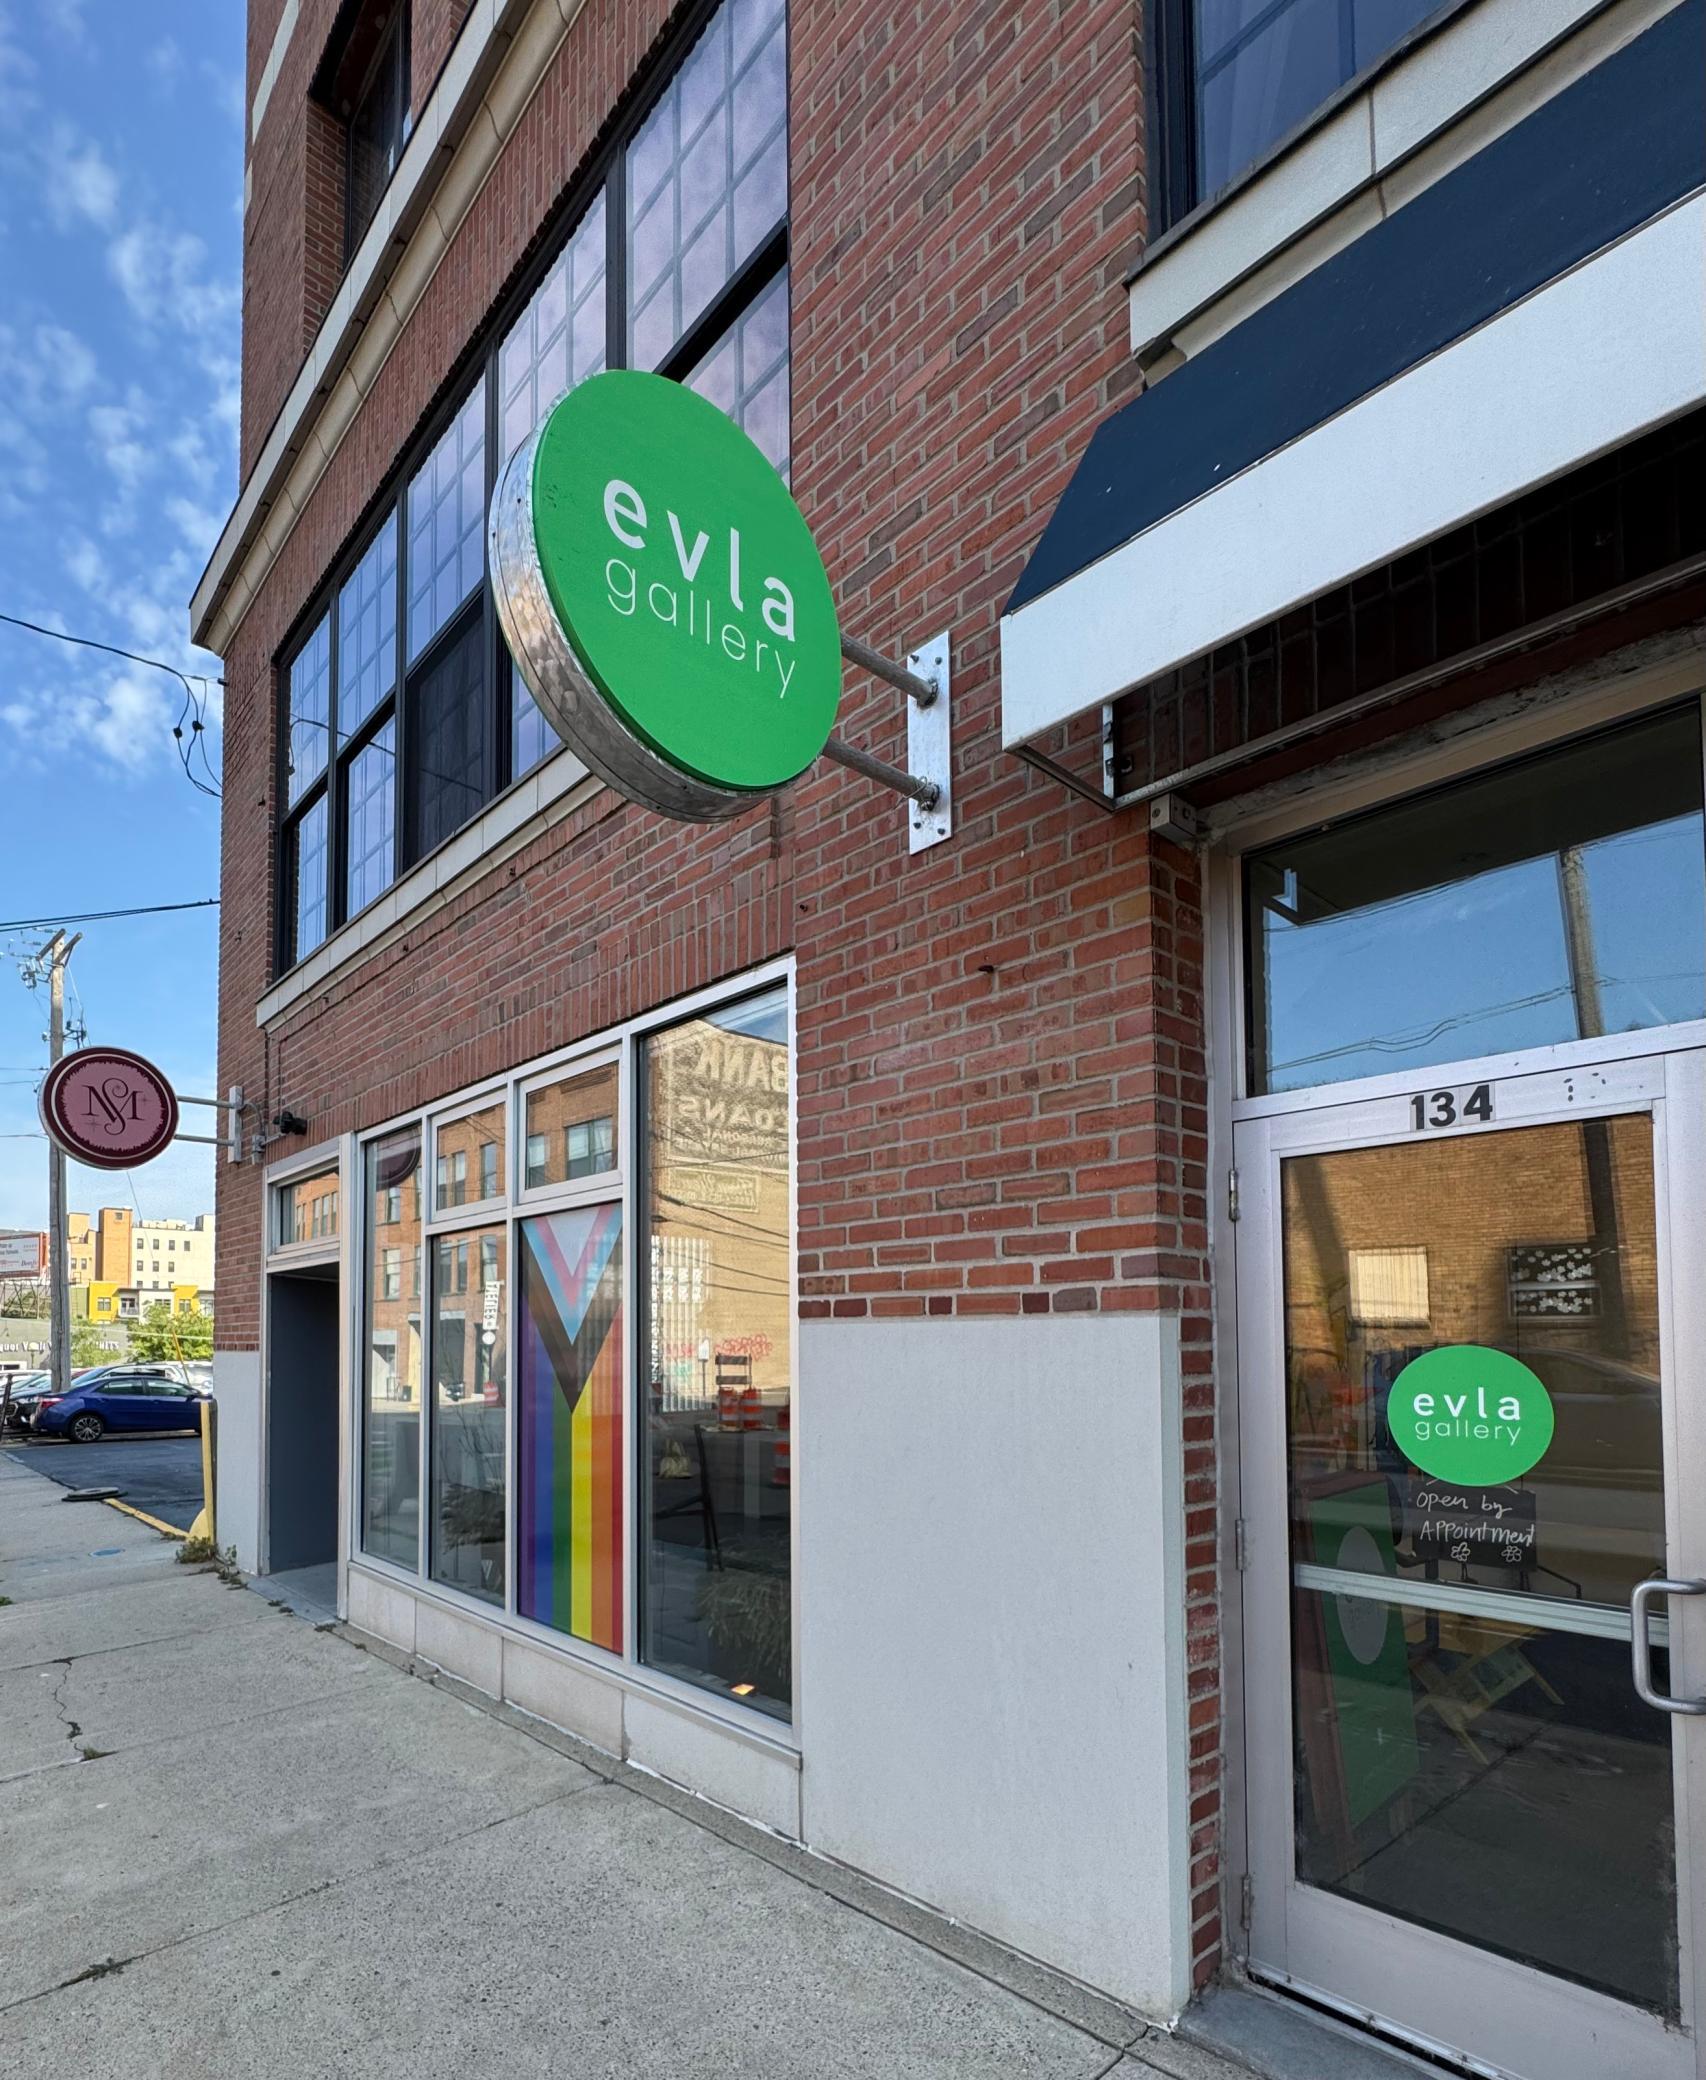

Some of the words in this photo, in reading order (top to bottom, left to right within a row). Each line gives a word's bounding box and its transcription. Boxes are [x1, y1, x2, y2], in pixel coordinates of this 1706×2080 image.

[603, 479, 796, 642] evla
[605, 558, 796, 699] gallery
[1411, 1084, 1493, 1130] 134
[1413, 1387, 1521, 1421] evla
[1414, 1418, 1521, 1447] gallery
[1480, 1494, 1513, 1519] by
